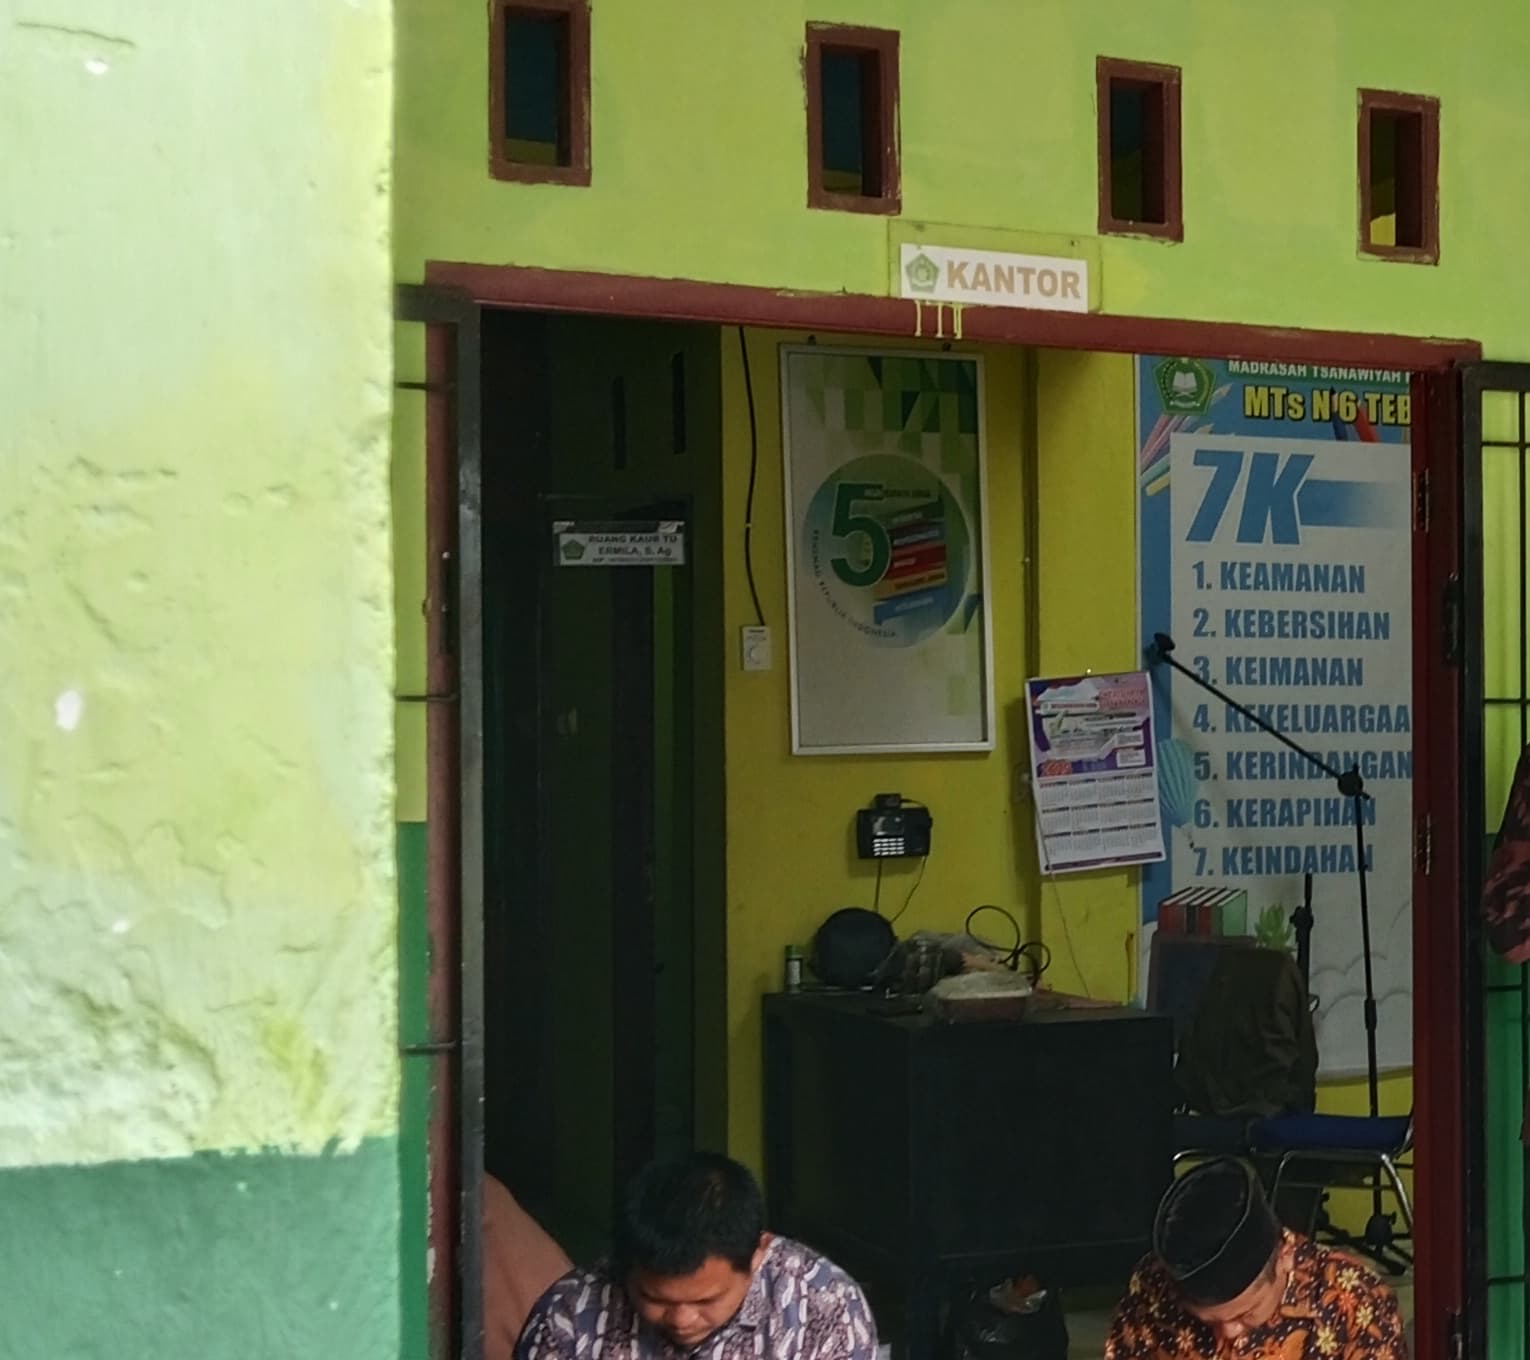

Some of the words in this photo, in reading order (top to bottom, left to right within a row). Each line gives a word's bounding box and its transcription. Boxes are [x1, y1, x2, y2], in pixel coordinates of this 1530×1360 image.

[946, 259, 1081, 300] KANTOR
[1243, 384, 1306, 421] MTs
[1312, 388, 1333, 422] N
[1337, 390, 1359, 423] 6
[1185, 449, 1316, 545] 7K
[829, 482, 893, 588] 5
[1192, 561, 1213, 591] 1.
[1220, 561, 1366, 593] KEAMANAN
[1192, 607, 1217, 639] 2.
[1225, 609, 1390, 641] KEBERSIHAN
[1192, 655, 1218, 686] 3.
[1226, 656, 1364, 687] KEIMANAN
[1192, 704, 1217, 734] 4.
[1193, 751, 1219, 781] 5.
[1193, 798, 1219, 829] 6.
[1226, 796, 1377, 829] KERAPIHAN
[1192, 846, 1215, 877] 7.
[1222, 843, 1374, 877] KEINDAHAN
